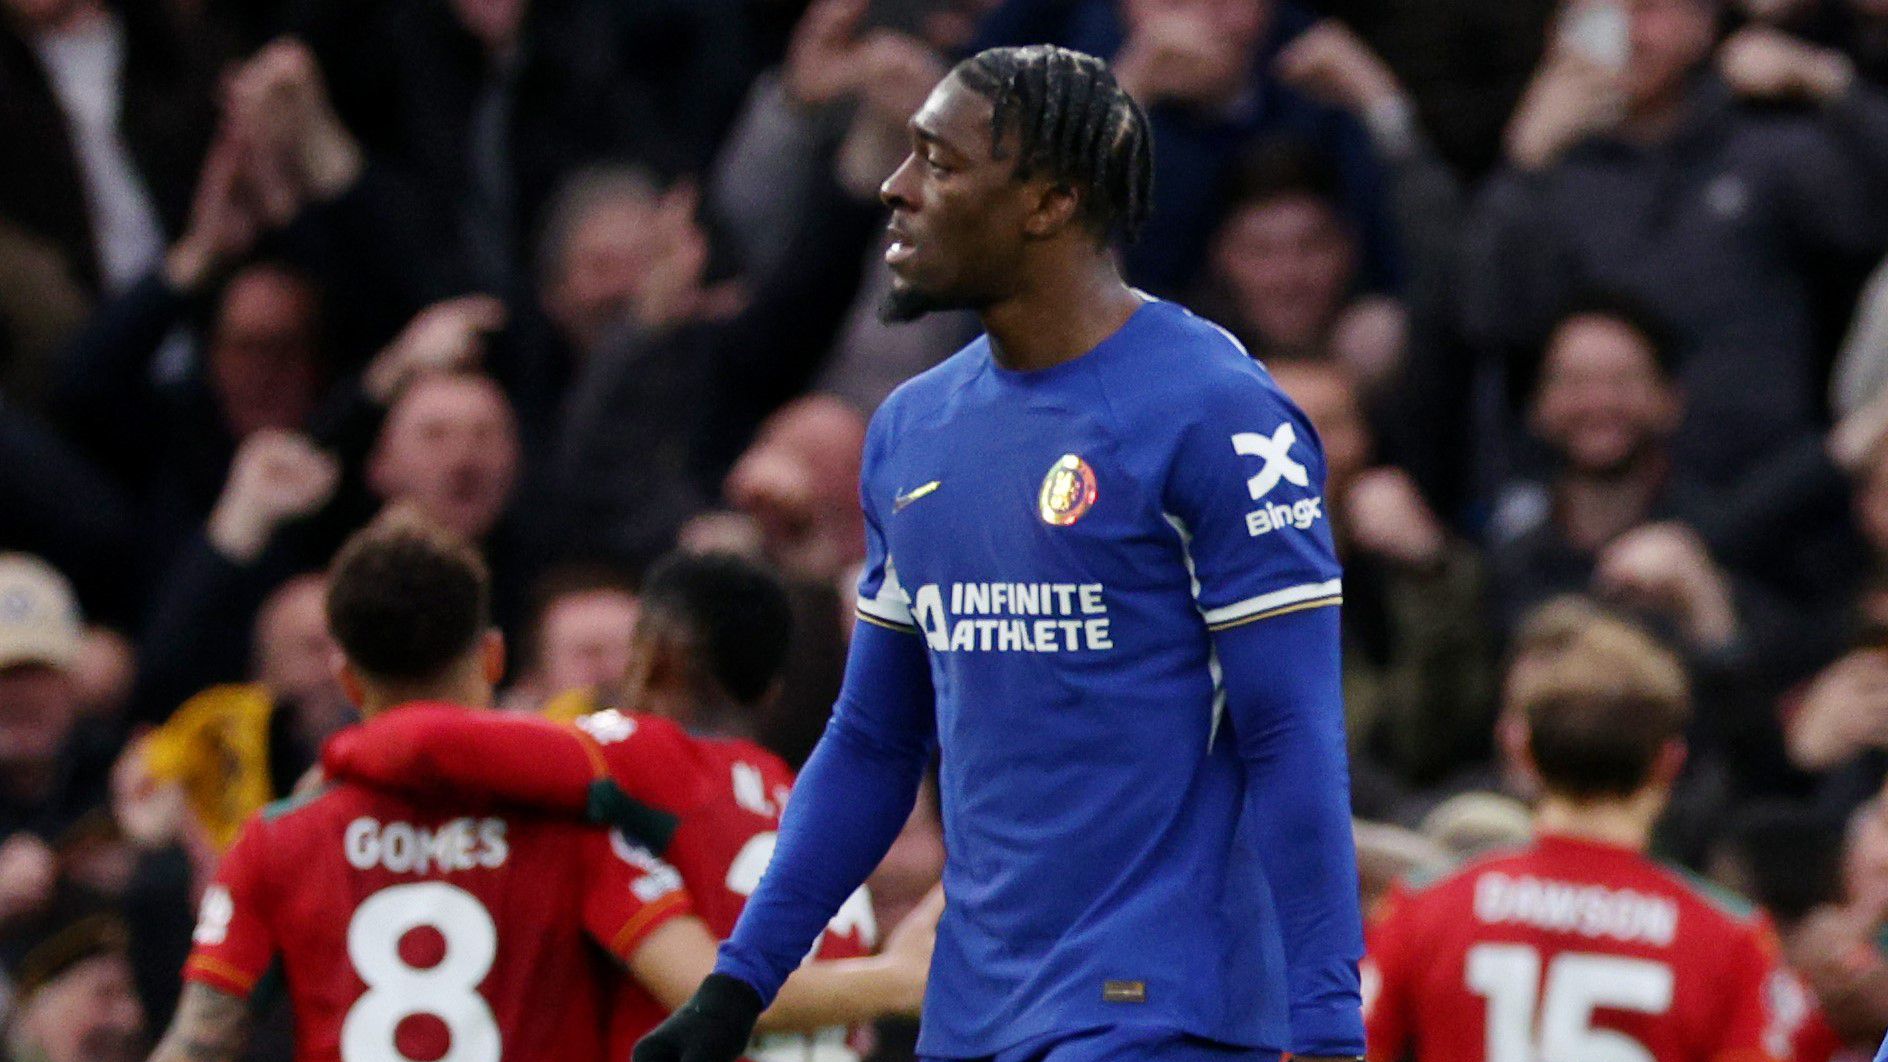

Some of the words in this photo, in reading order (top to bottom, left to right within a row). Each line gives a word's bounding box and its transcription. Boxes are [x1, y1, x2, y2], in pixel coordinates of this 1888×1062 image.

[951, 582, 1107, 616] INFINITE
[950, 618, 1113, 653] ATHLETE
[343, 815, 511, 875] GOMES
